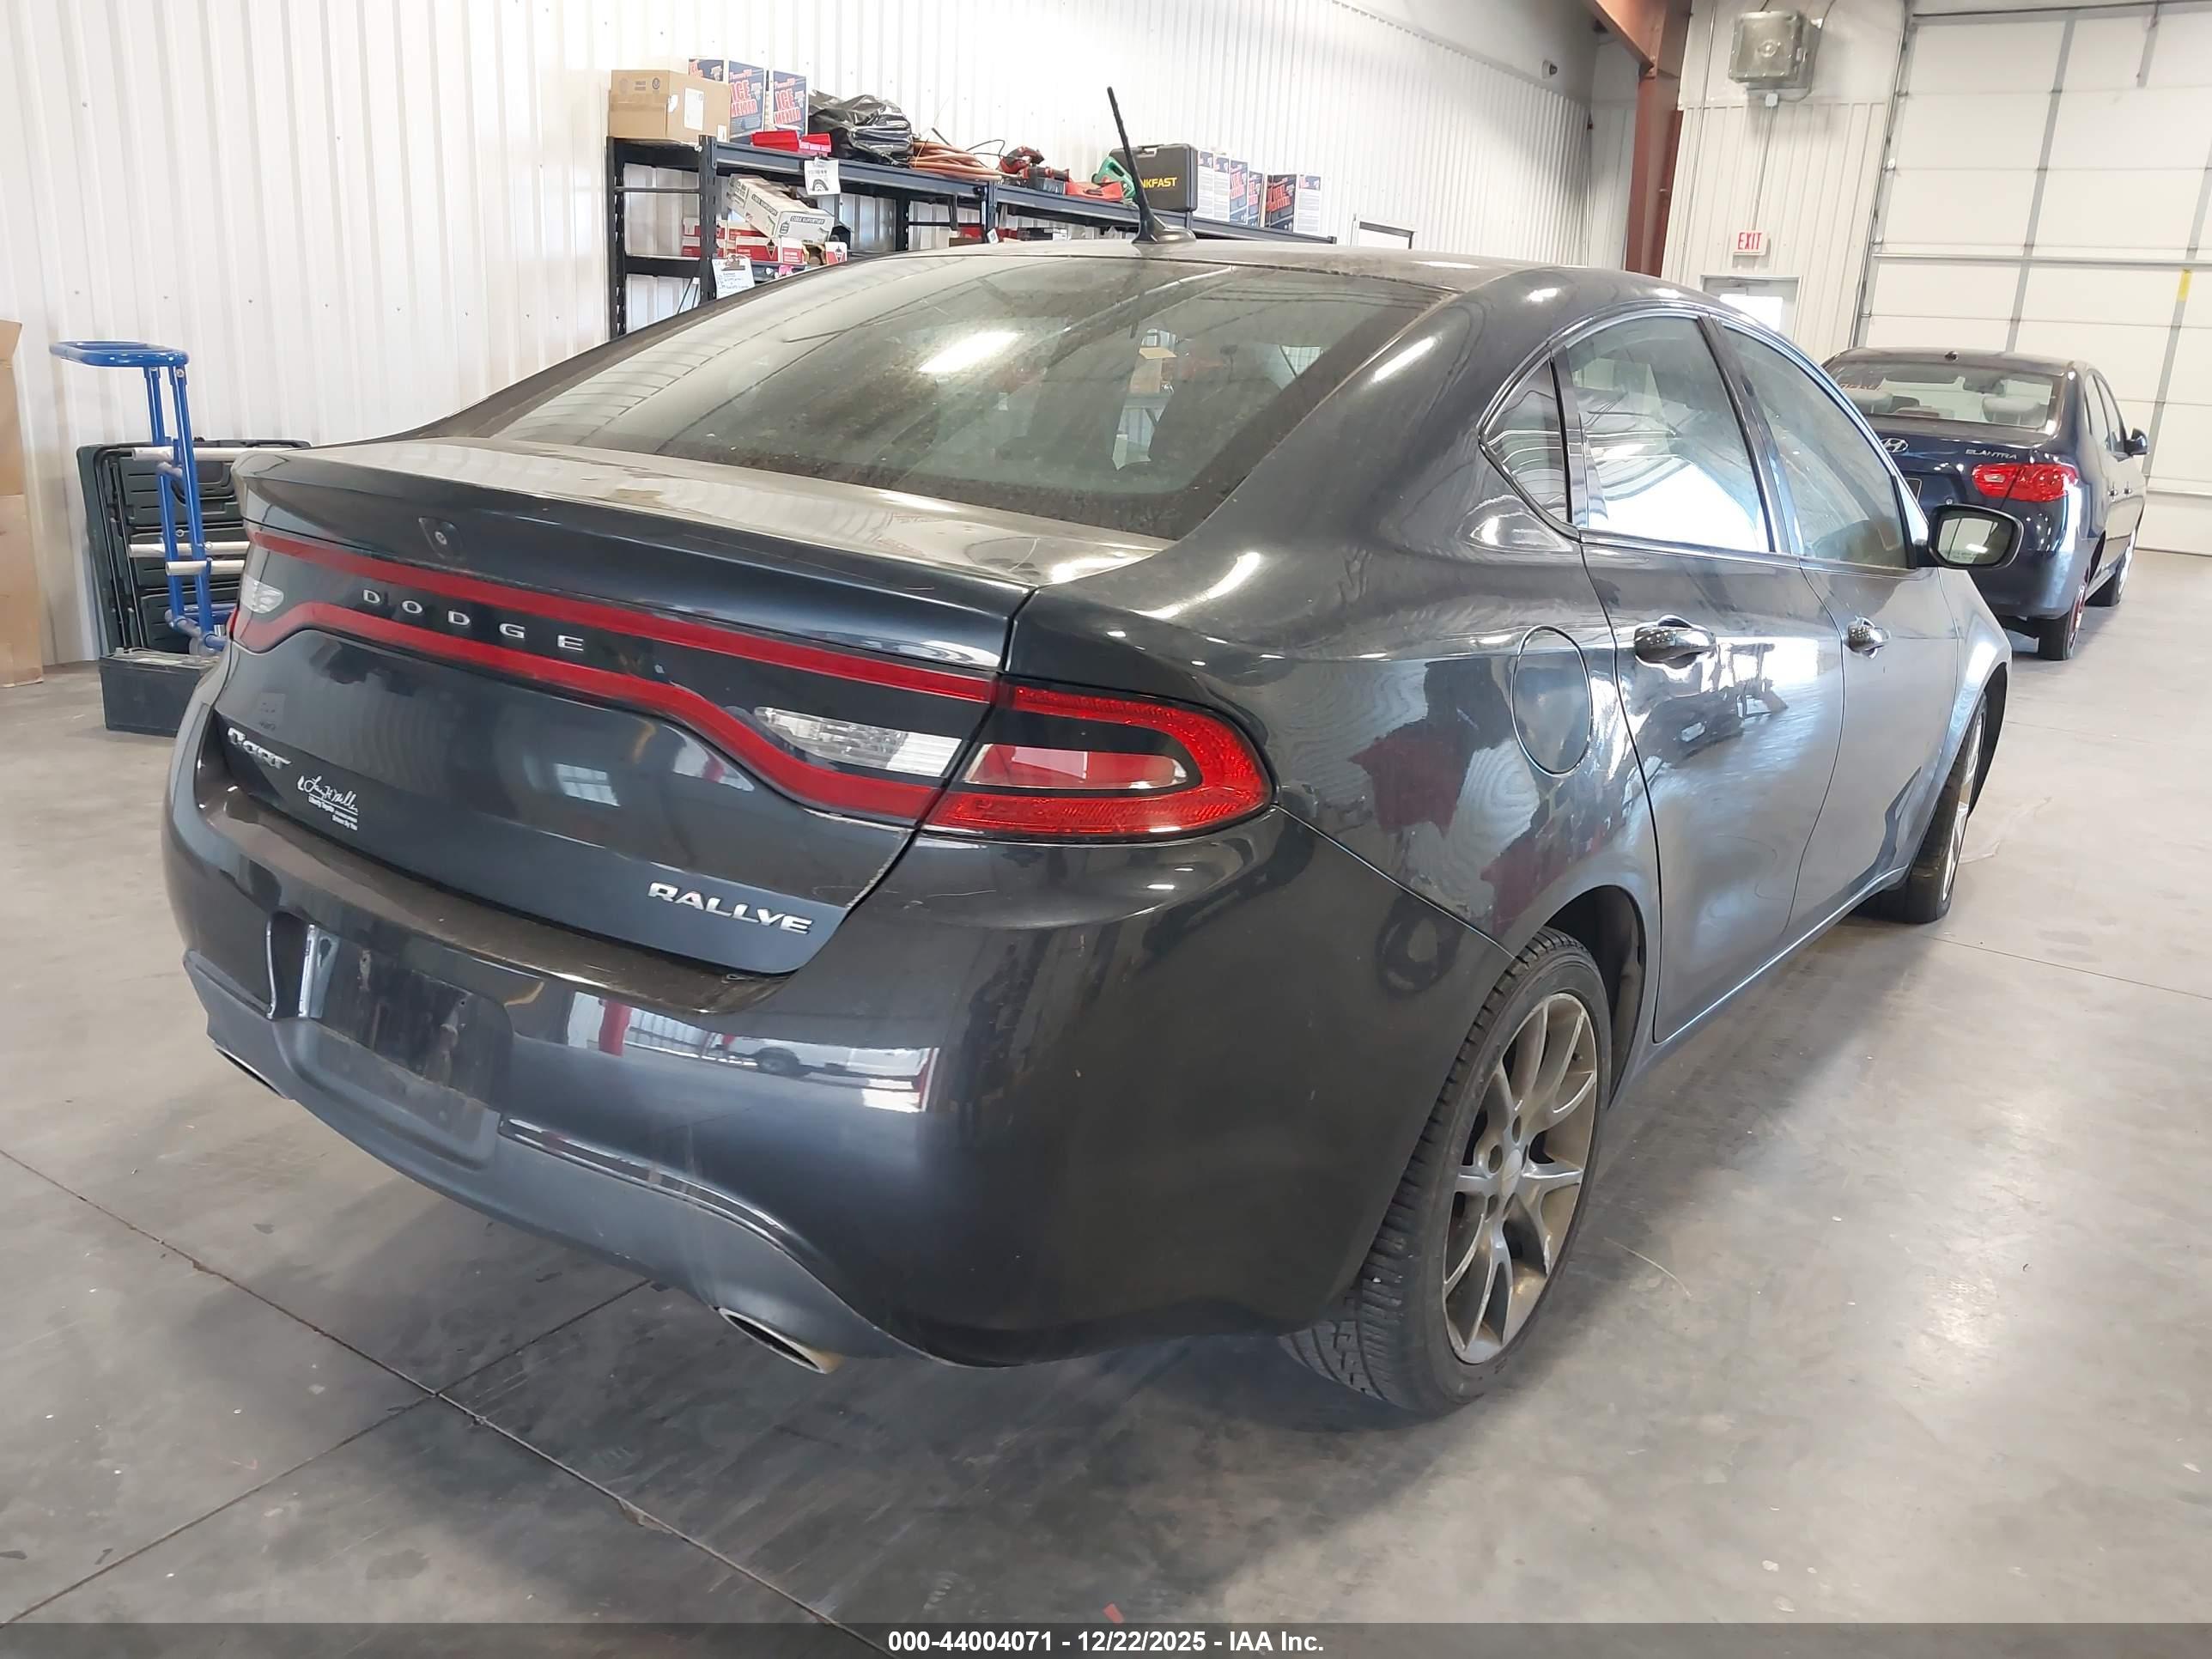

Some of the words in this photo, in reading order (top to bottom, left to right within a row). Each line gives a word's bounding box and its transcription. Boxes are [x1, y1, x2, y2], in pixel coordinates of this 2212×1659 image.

[775, 88, 795, 112] ICE
[1737, 232, 1763, 250] EXIT
[1965, 448, 2017, 460] ELANTRA
[362, 588, 585, 653] DODGE
[647, 881, 814, 935] RALLYE
